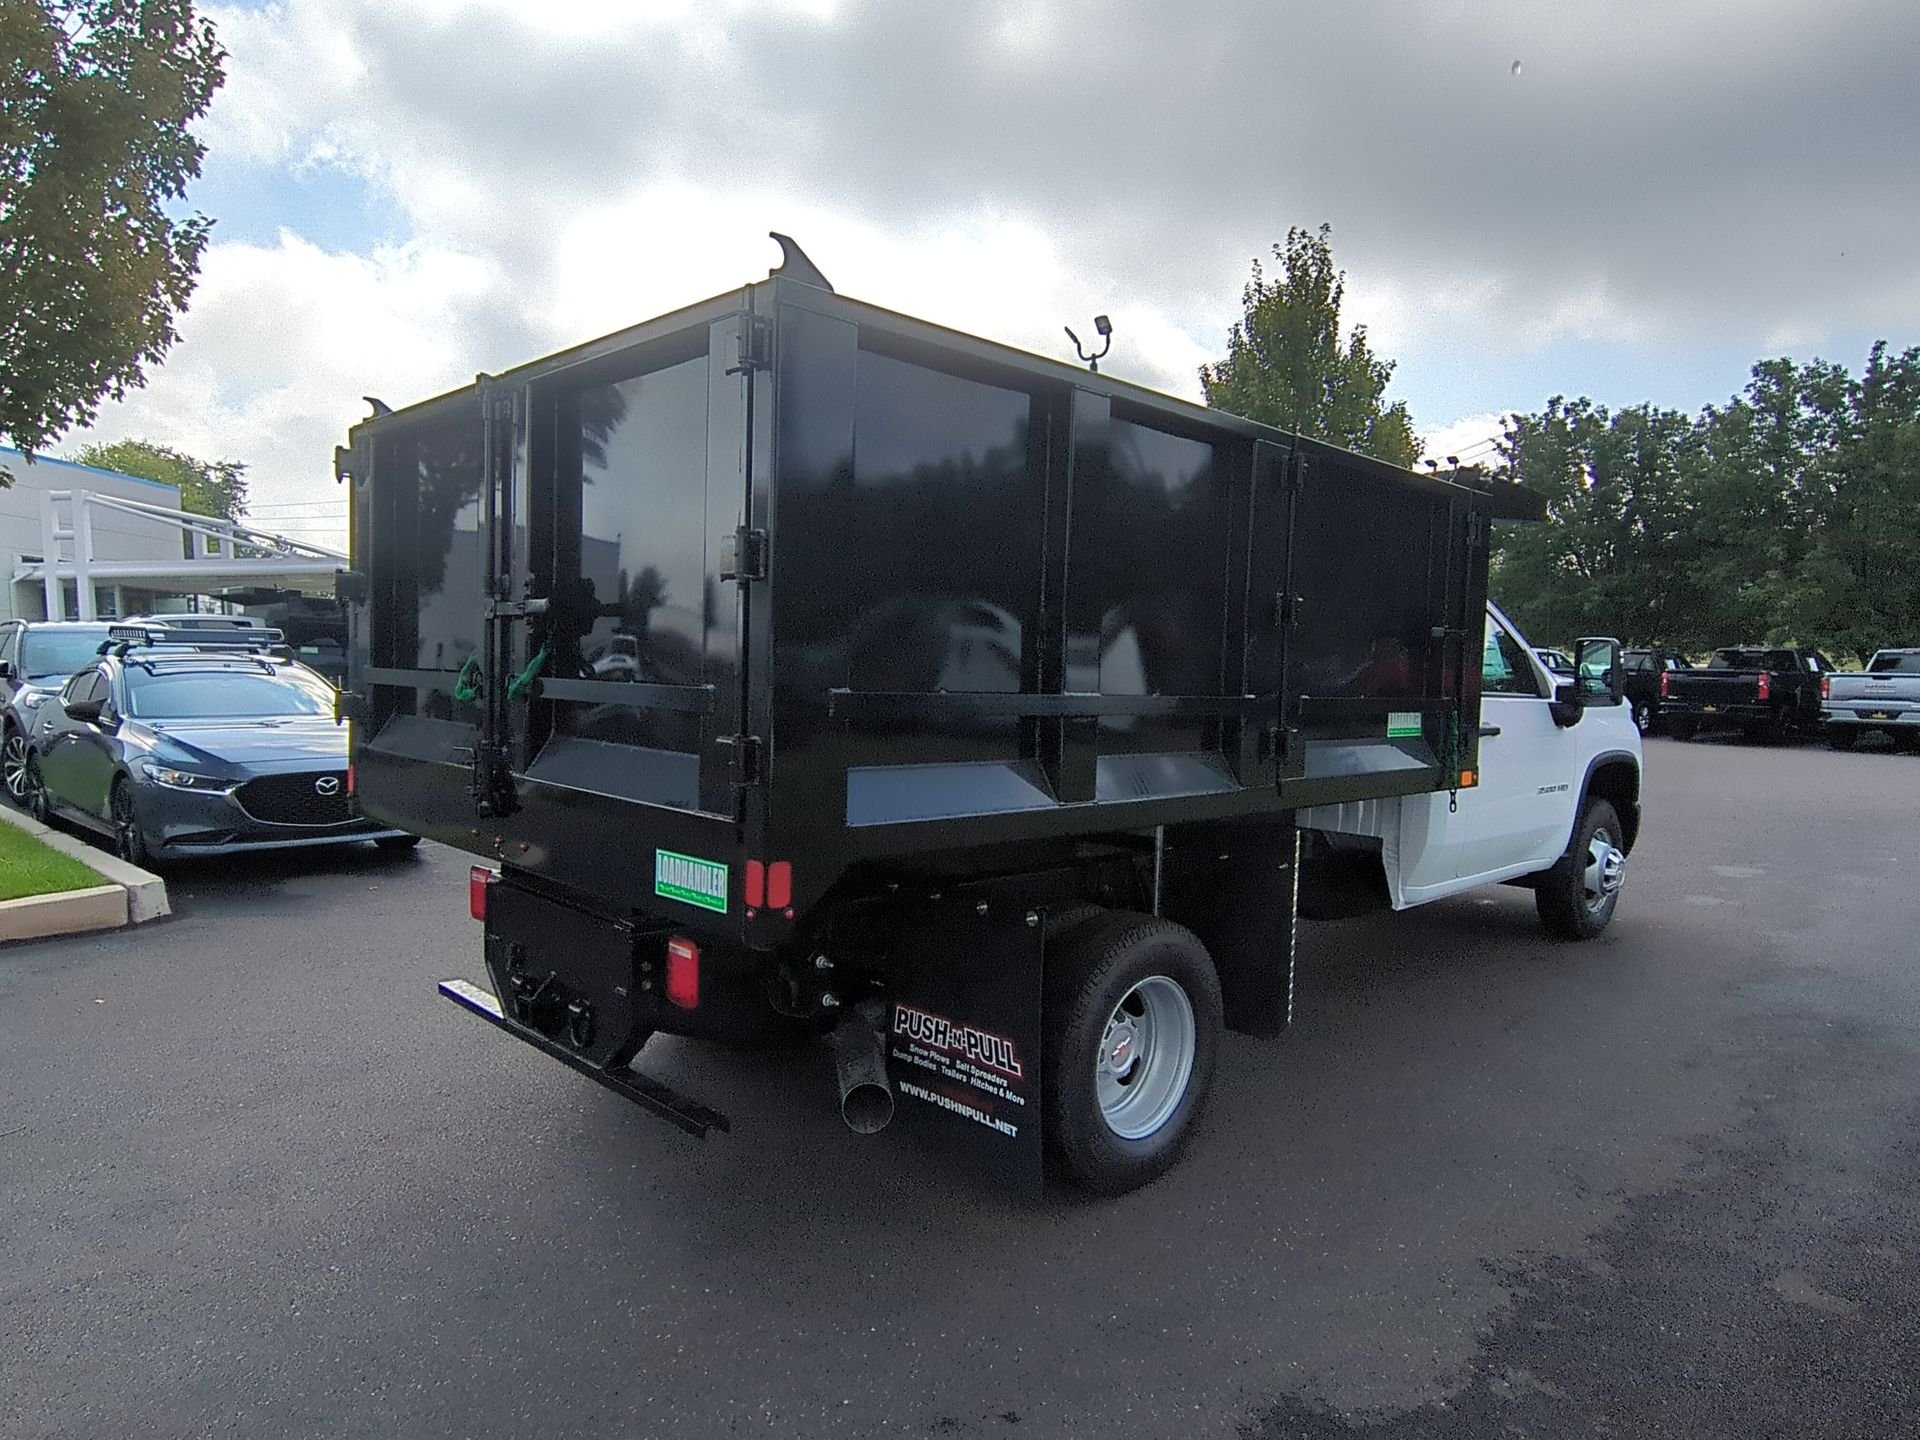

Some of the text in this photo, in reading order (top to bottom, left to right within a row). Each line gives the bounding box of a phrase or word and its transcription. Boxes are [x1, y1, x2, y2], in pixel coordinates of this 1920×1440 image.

[657, 854, 725, 899] LOADHANDLER
[893, 1048, 1025, 1106] Dump Bodies Trailers Hitches & More
[909, 1043, 1008, 1087] Snow Plows Salt Spreaders
[899, 1080, 1018, 1138] WWW.PUSHNPULL.NET
